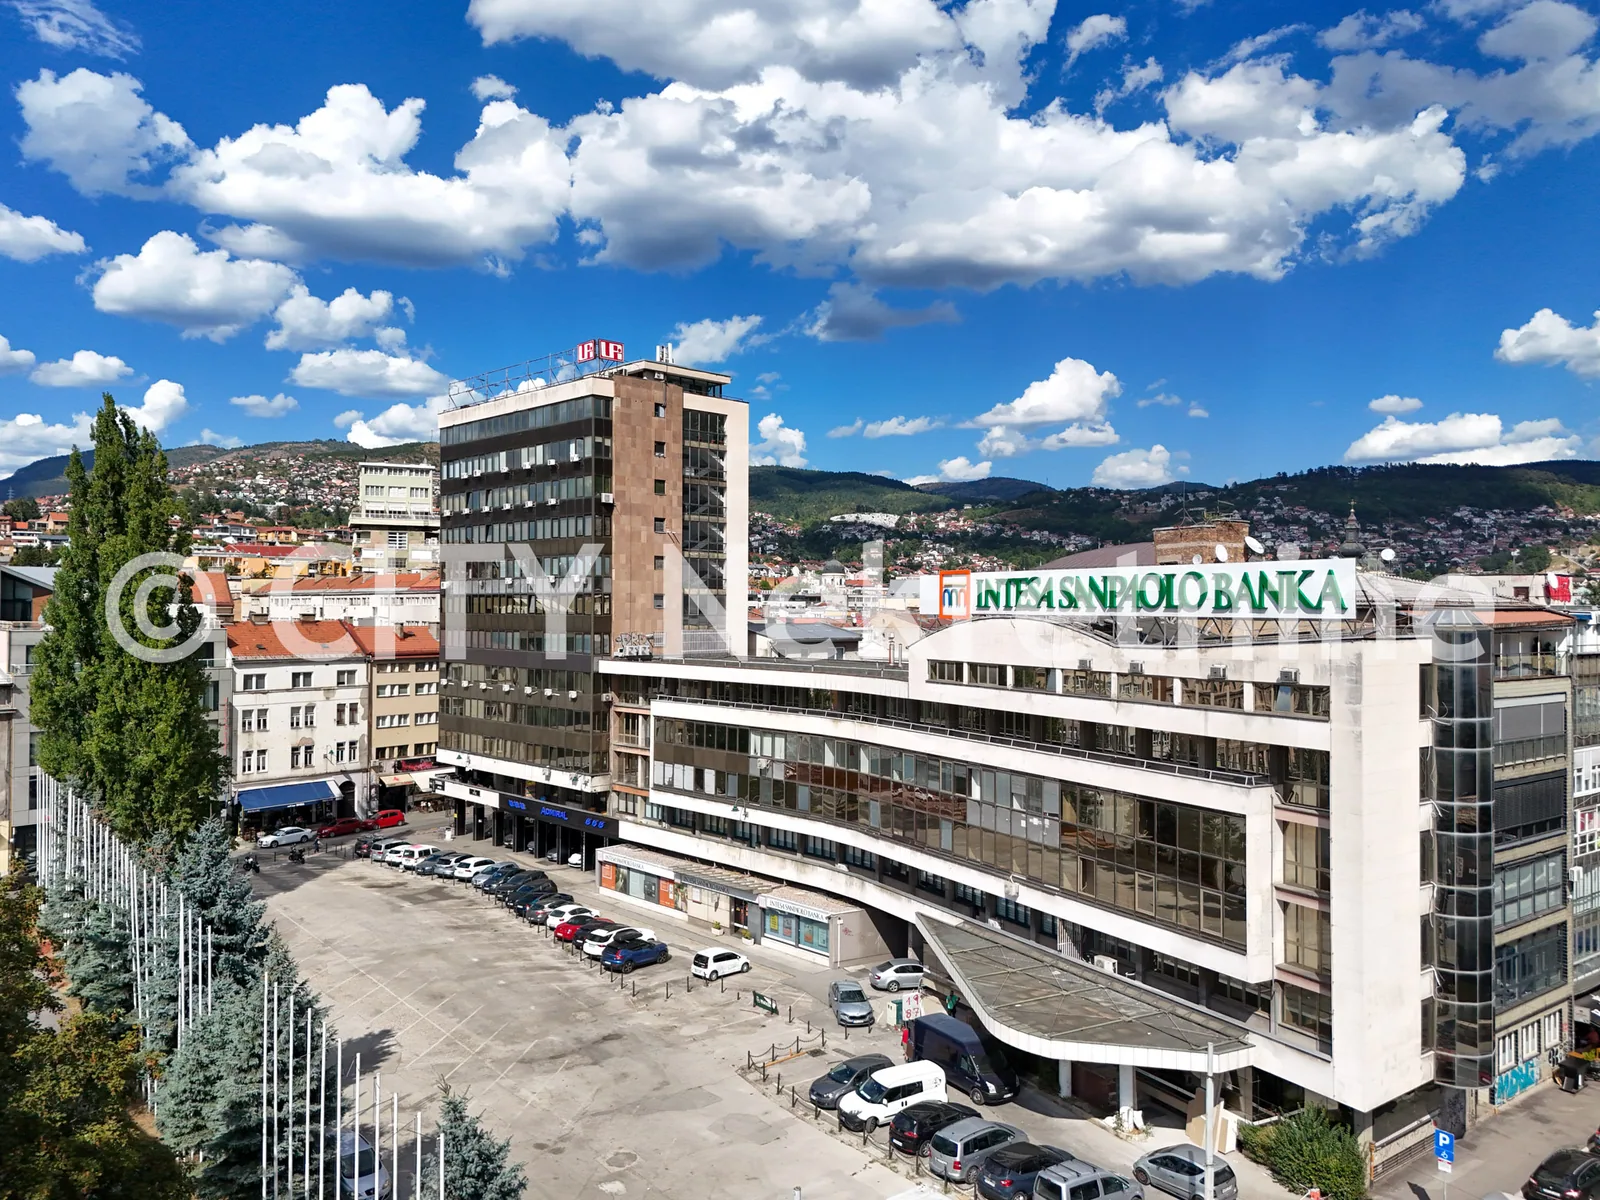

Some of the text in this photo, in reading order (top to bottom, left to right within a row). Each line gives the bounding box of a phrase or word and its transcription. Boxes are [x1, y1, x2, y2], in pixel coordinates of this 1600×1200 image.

[976, 569, 1349, 611] INTESA SANPAOLO BANKA
[1438, 1132, 1450, 1147] P
